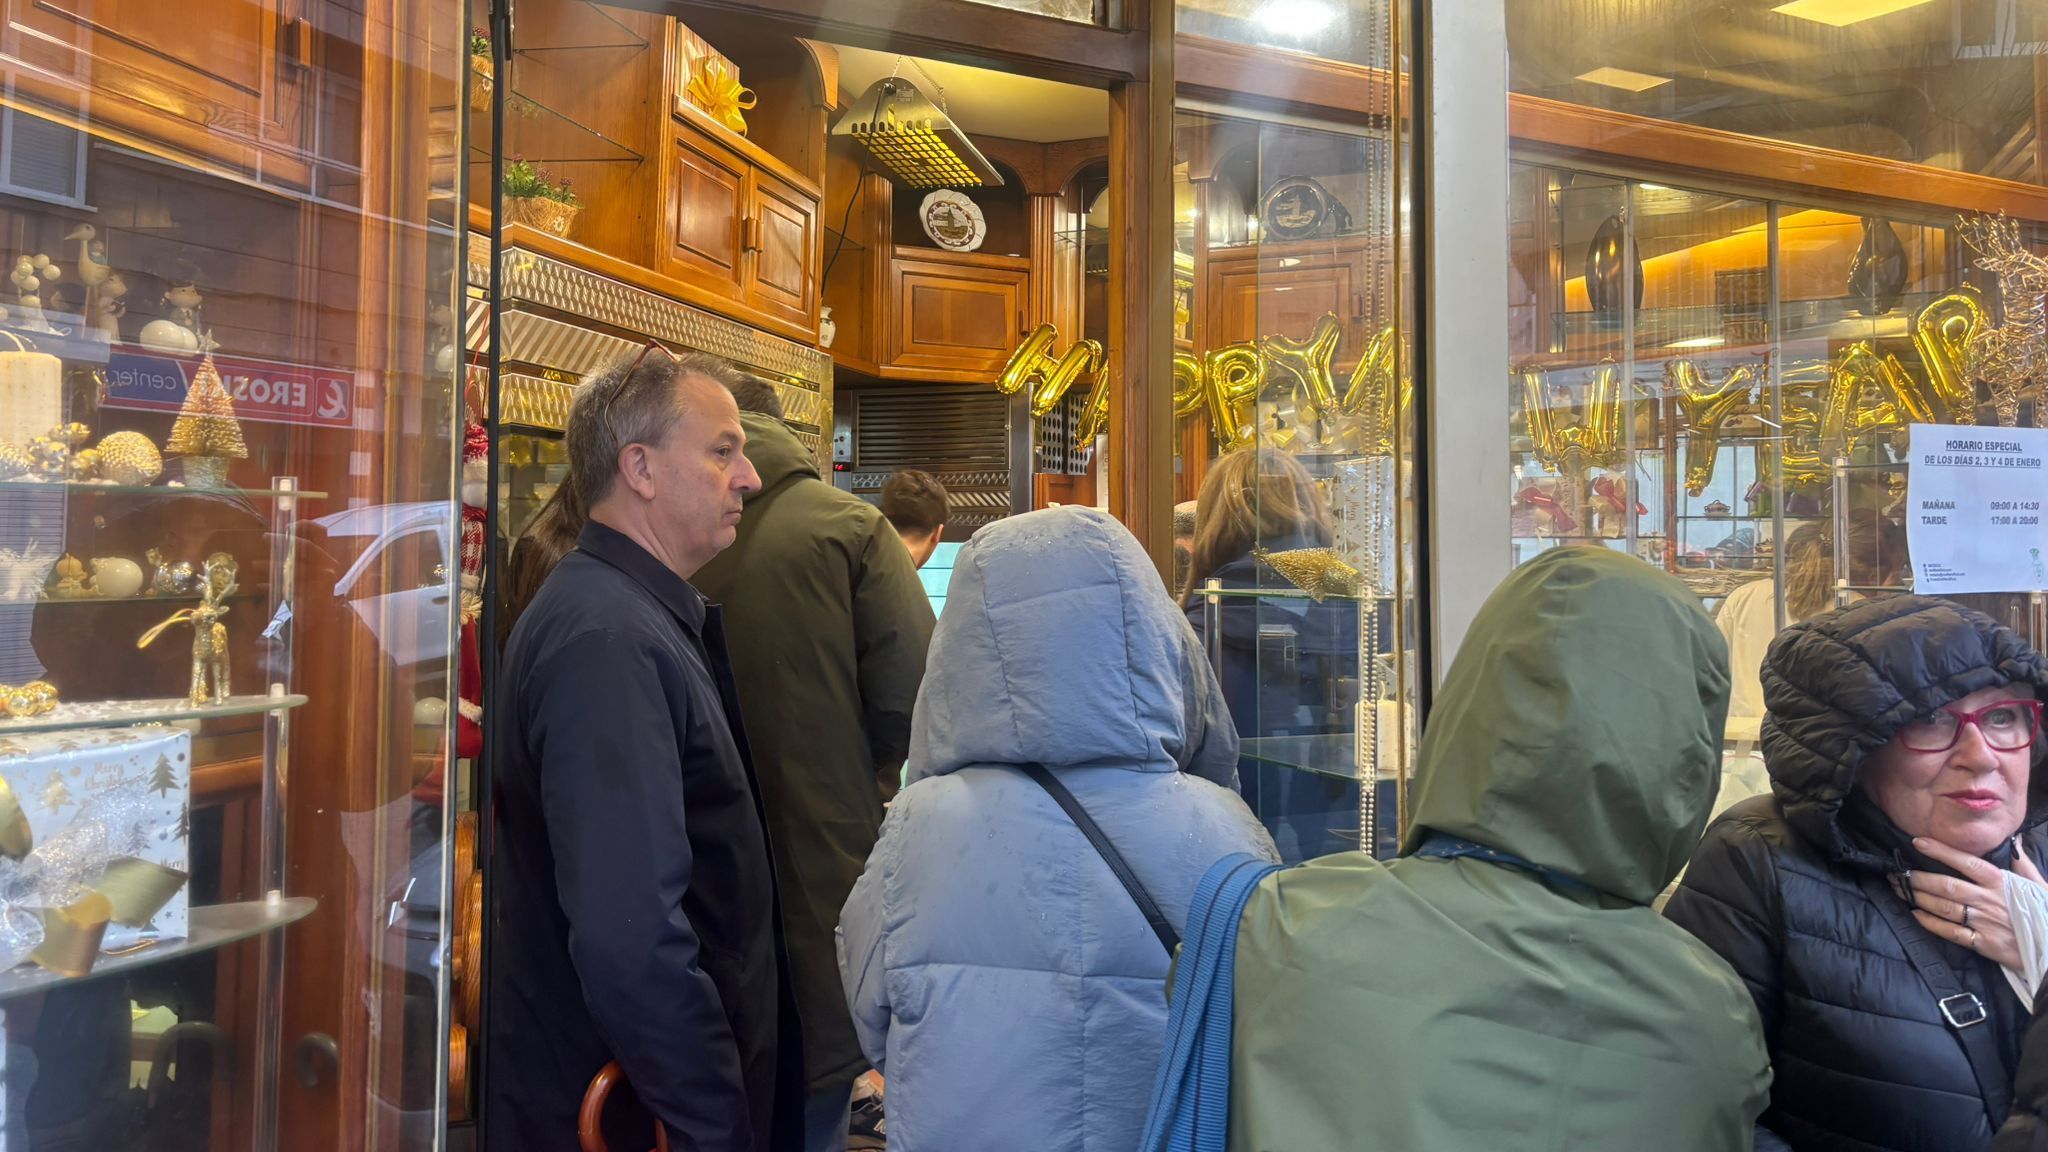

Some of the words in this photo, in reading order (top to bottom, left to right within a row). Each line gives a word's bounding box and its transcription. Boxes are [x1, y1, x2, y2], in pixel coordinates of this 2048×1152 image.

[1945, 440, 1983, 450] HORARIO
[1984, 441, 2023, 452] ESPECIAL
[1924, 455, 1935, 464] DE
[1936, 455, 1953, 465] LOS
[1954, 453, 1974, 466] DÍAS
[2004, 457, 2015, 467] DE
[2016, 457, 2041, 467] ENERO
[1921, 499, 1956, 510] MAÑANA
[1990, 501, 2011, 510] 09:00
[2019, 502, 2040, 511] 14:30
[1920, 515, 1948, 525] TARDE
[1990, 516, 2011, 525] 17:00
[2019, 516, 2039, 525] 20:00
